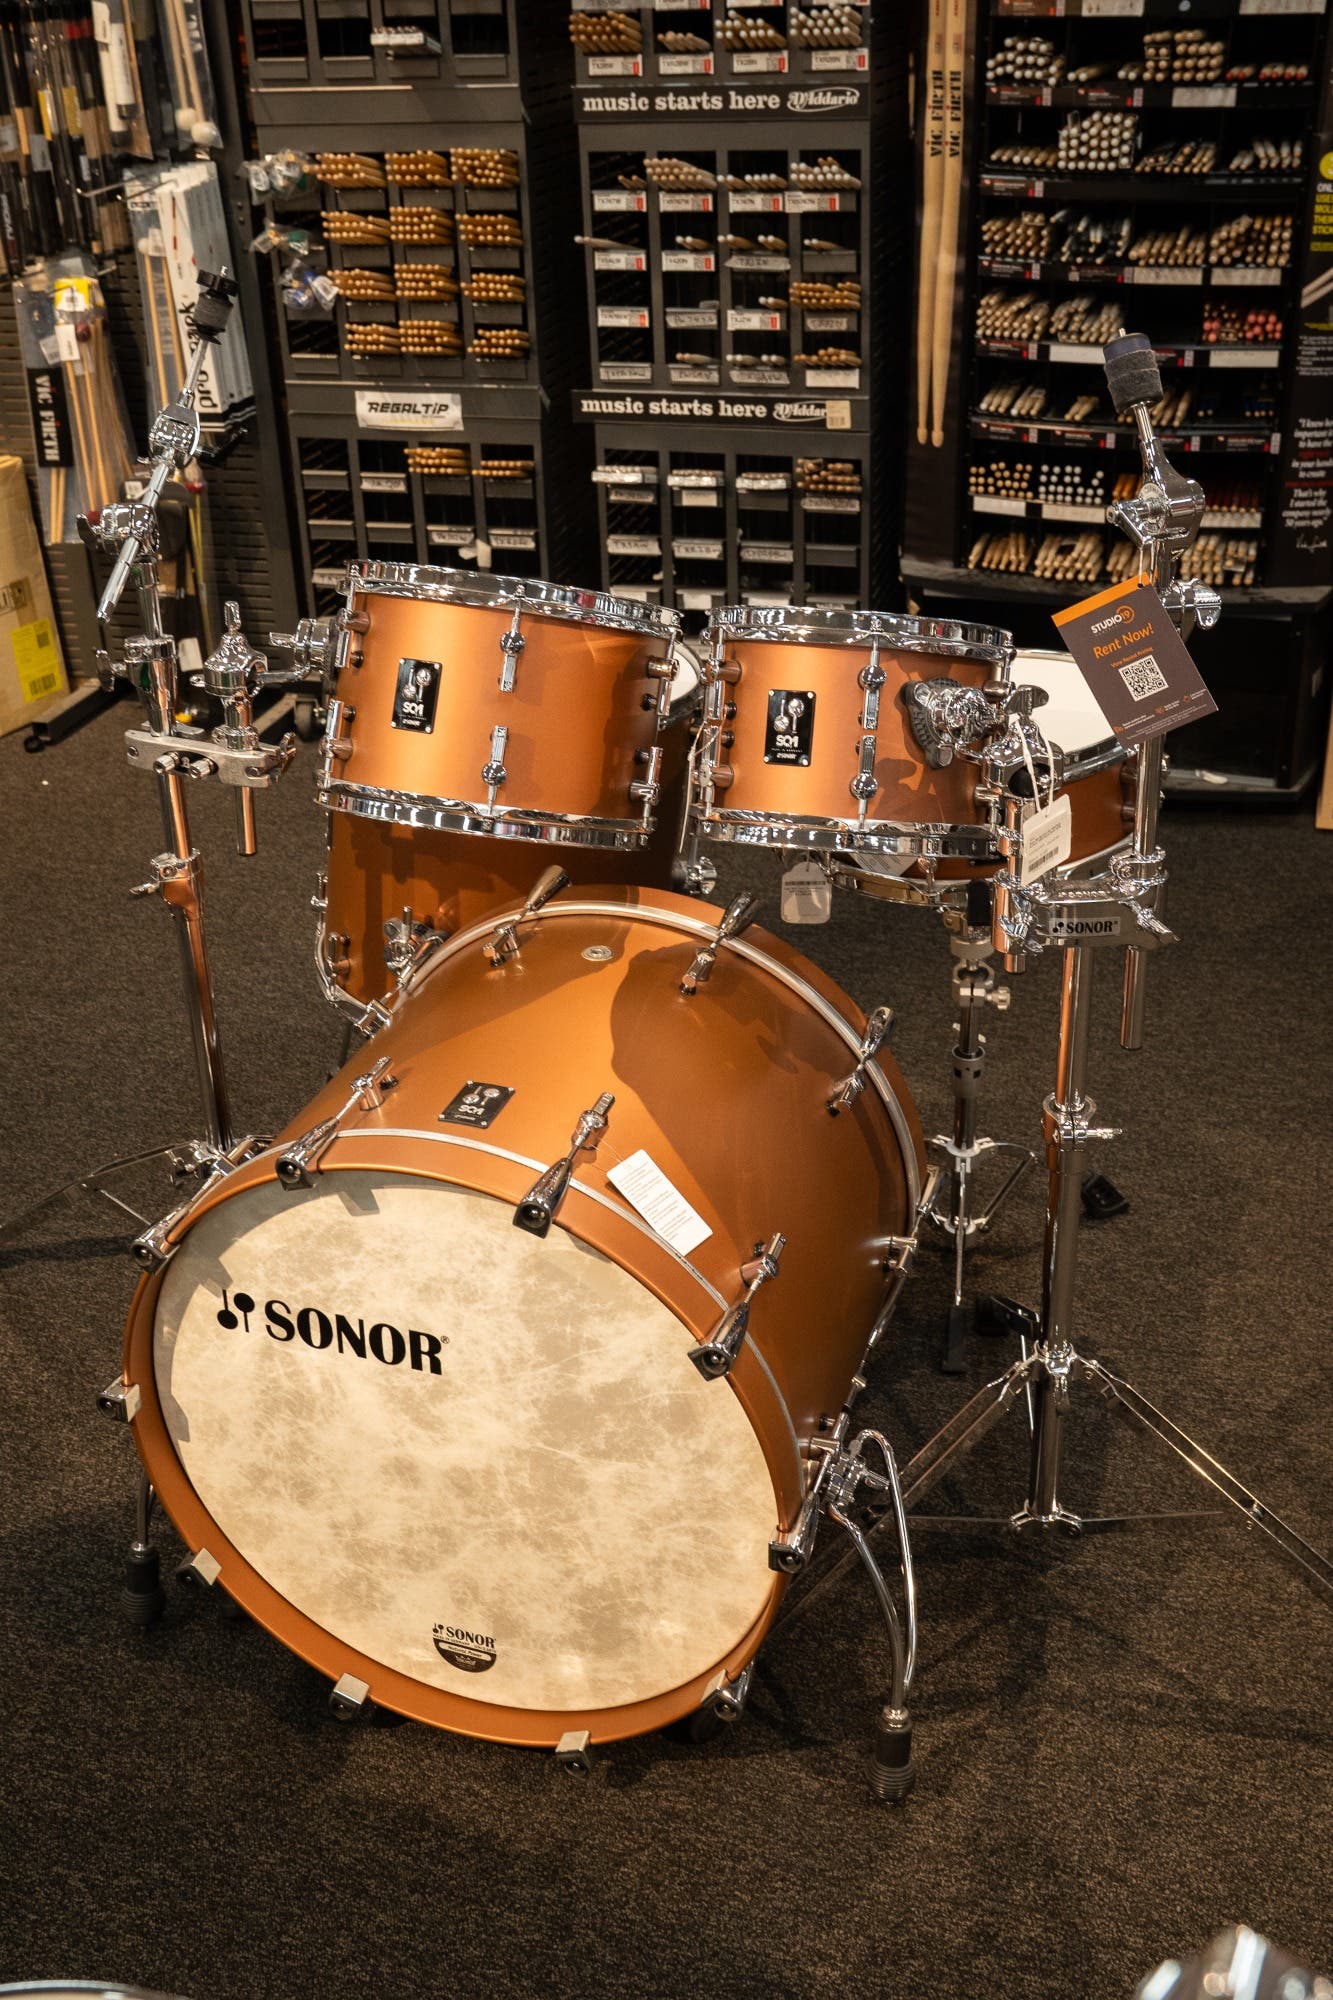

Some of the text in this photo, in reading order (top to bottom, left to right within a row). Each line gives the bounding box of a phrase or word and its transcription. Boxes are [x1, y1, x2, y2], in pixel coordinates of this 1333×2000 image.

[583, 92, 649, 112] music
[655, 91, 722, 111] starts
[729, 91, 780, 109] here
[581, 396, 644, 413] music
[649, 399, 714, 416] starts
[719, 400, 767, 417] here
[35, 375, 61, 461] VIC FIRTH
[1093, 638, 1122, 659] Rent
[1121, 622, 1155, 646] Now!
[776, 734, 799, 748] SQ1
[1066, 920, 1113, 934] SONOR
[446, 1626, 495, 1649] SONOR
